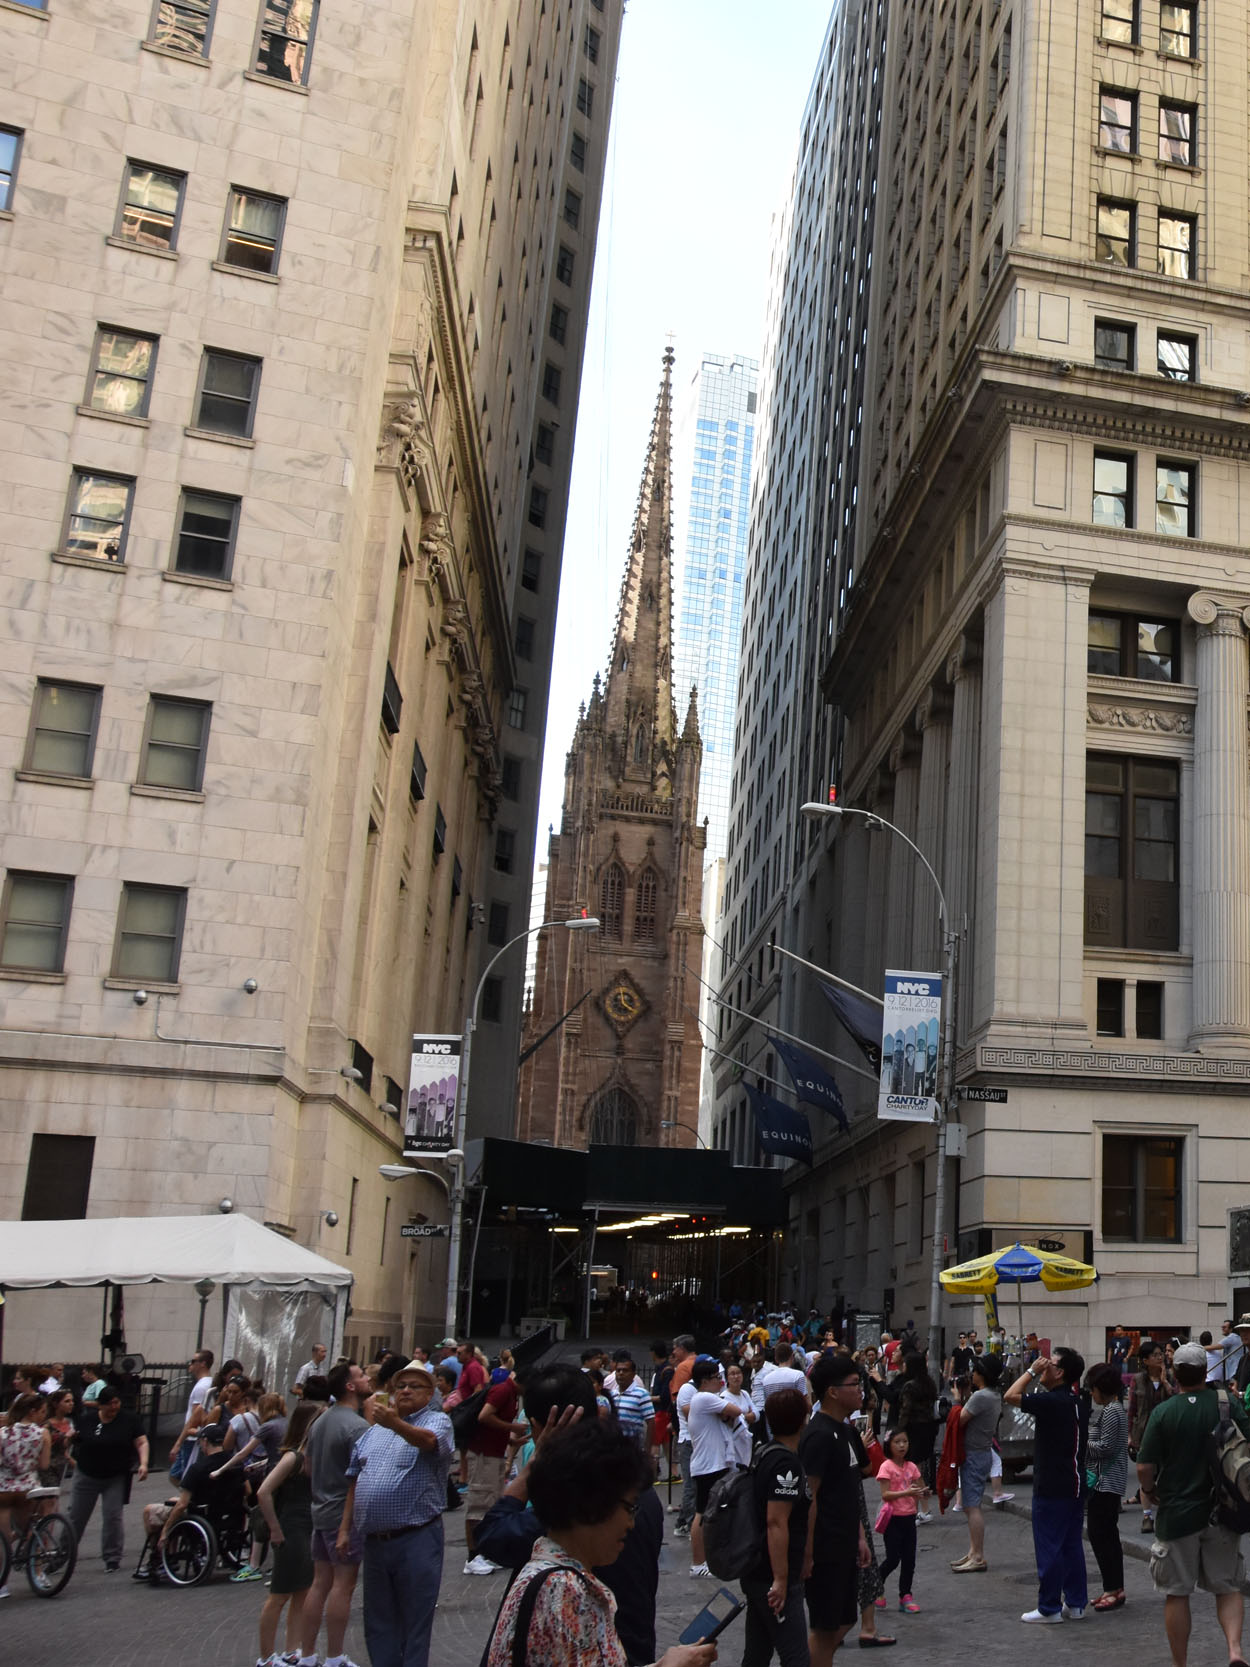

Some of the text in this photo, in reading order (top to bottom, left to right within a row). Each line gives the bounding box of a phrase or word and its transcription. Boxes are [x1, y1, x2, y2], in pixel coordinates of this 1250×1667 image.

[896, 981, 930, 995] NYC
[914, 997, 938, 1009] 2016
[423, 1043, 452, 1054] NYC
[886, 1095, 929, 1106] CANTOR
[968, 1089, 1000, 1101] NASSAU
[402, 1227, 432, 1236] BROAD
[775, 1488, 798, 1496] adidas
